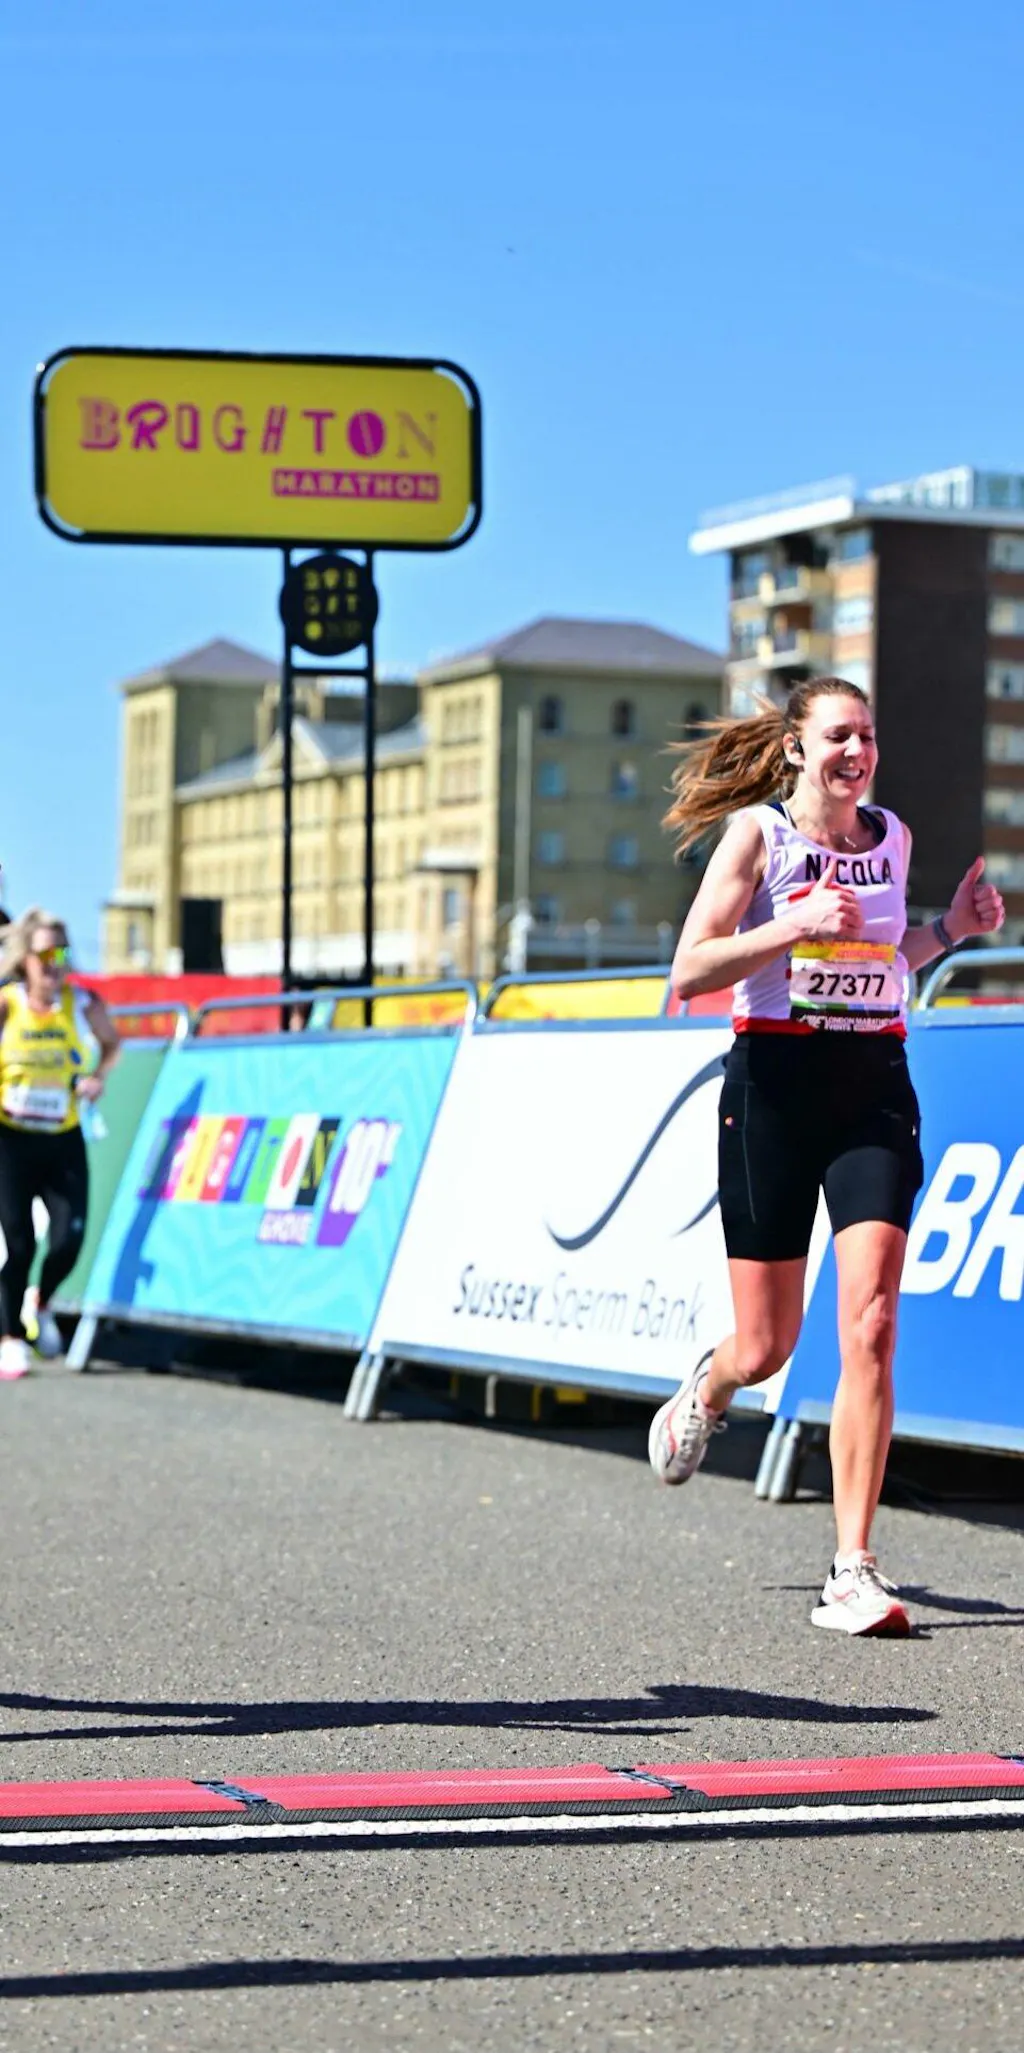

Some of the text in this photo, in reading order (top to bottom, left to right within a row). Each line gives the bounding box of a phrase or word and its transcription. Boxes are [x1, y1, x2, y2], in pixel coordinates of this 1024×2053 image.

[78, 397, 437, 460] BRIGHTON
[276, 471, 437, 498] MARATHON
[807, 972, 885, 997] 27377
[452, 1263, 704, 1342] Sussex Sperm Bank
